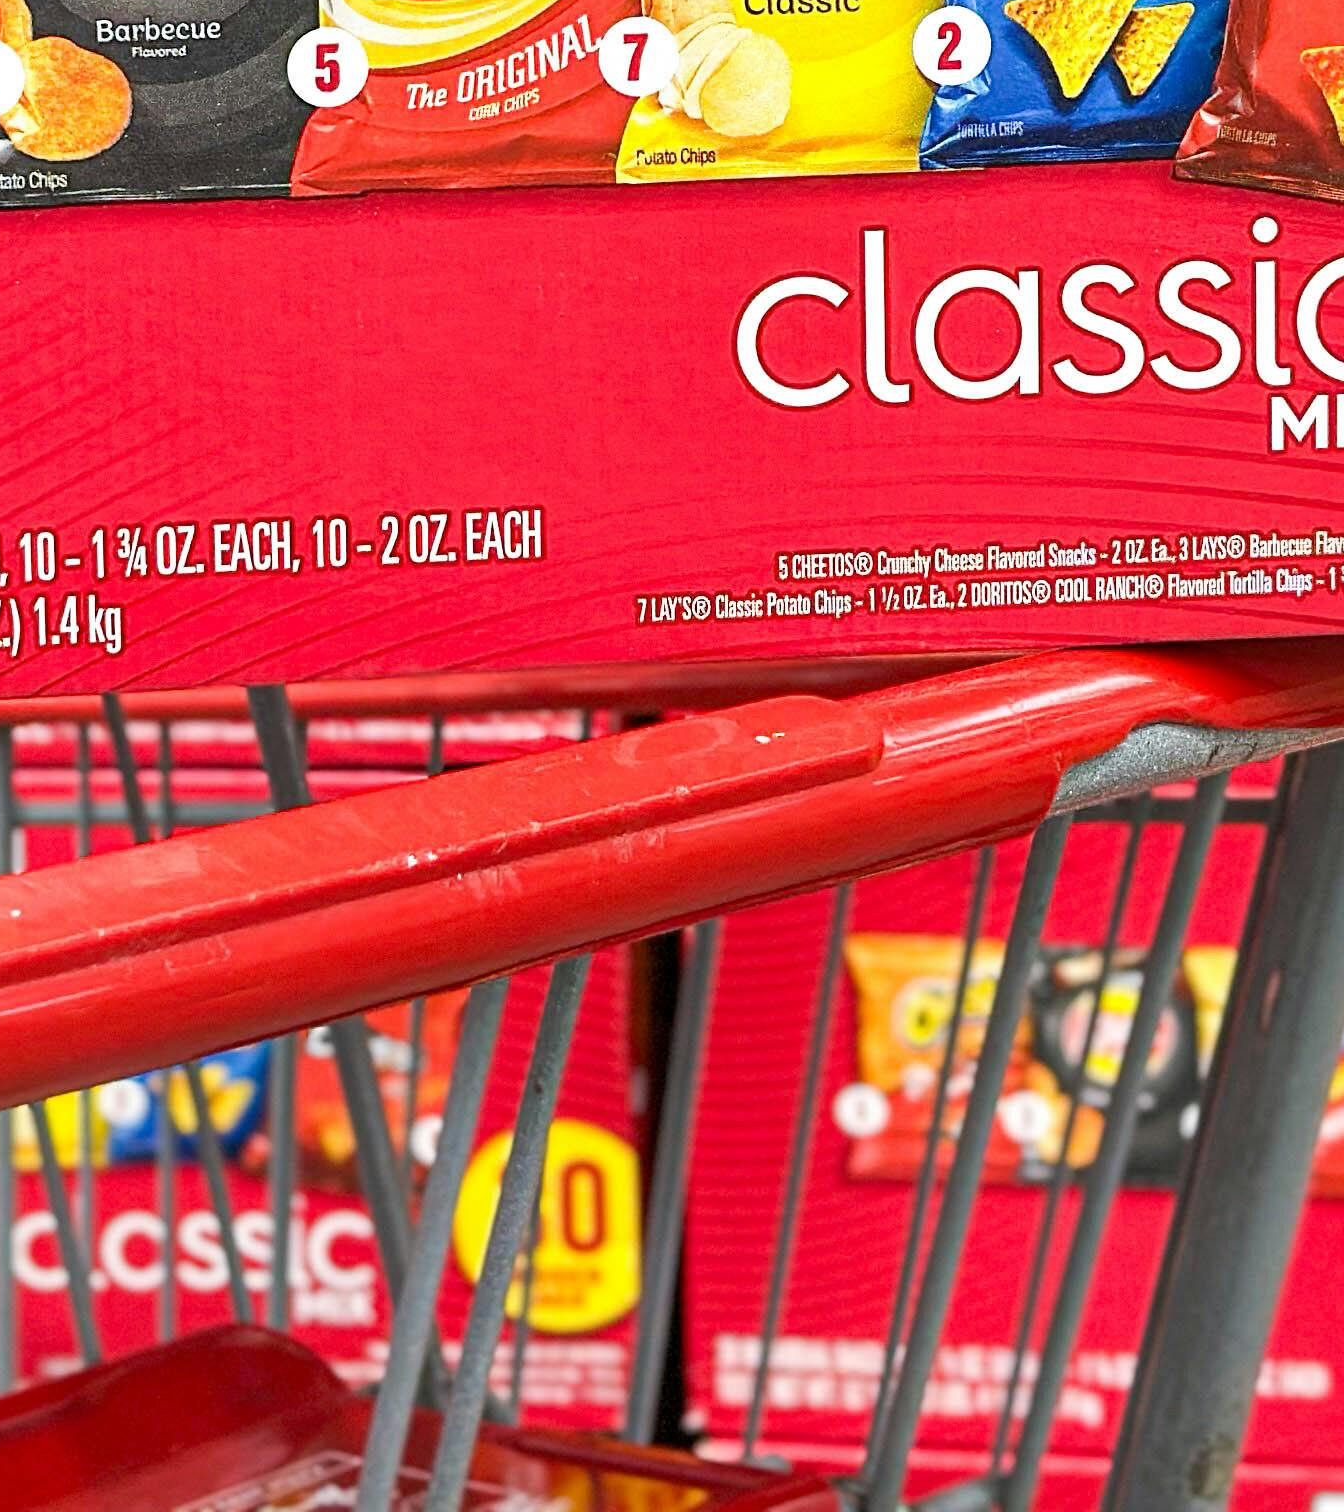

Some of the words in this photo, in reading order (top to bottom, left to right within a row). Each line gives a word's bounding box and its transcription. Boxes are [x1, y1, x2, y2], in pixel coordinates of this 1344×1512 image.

[96, 18, 221, 42] Barbecue
[132, 45, 186, 58] Flavored
[937, 22, 963, 70] 2
[315, 44, 340, 91] 5
[406, 83, 447, 109] The
[457, 14, 603, 102] ORIGINAL
[623, 33, 648, 81] 7
[504, 88, 540, 113] CHIPS
[1000, 121, 1024, 137] CHIPS
[30, 170, 68, 191] Chips
[680, 148, 716, 167] Chips
[20, 532, 55, 581] 10
[93, 530, 104, 578] 1
[157, 526, 204, 574] OZ.
[214, 521, 300, 572] EACH,
[313, 519, 346, 567] 10
[382, 516, 399, 564] 2
[409, 514, 456, 562] OZ.
[466, 510, 541, 560] EACH
[878, 550, 931, 578] Crunchy
[935, 549, 983, 572] Cheese
[988, 544, 1044, 570] Flavored
[1049, 542, 1096, 567] Snacks
[1250, 534, 1312, 557] Barbecue
[716, 593, 763, 618] Classic
[767, 593, 810, 616] Potato
[815, 590, 851, 618] Chips
[1055, 578, 1092, 602] COOL
[1168, 572, 1224, 597] Flavored
[1228, 570, 1272, 594] Tortilla
[1276, 568, 1313, 596] Chips
[34, 596, 79, 645] 1.4
[89, 595, 121, 653] kg
[12, 1193, 374, 1291] cassic
